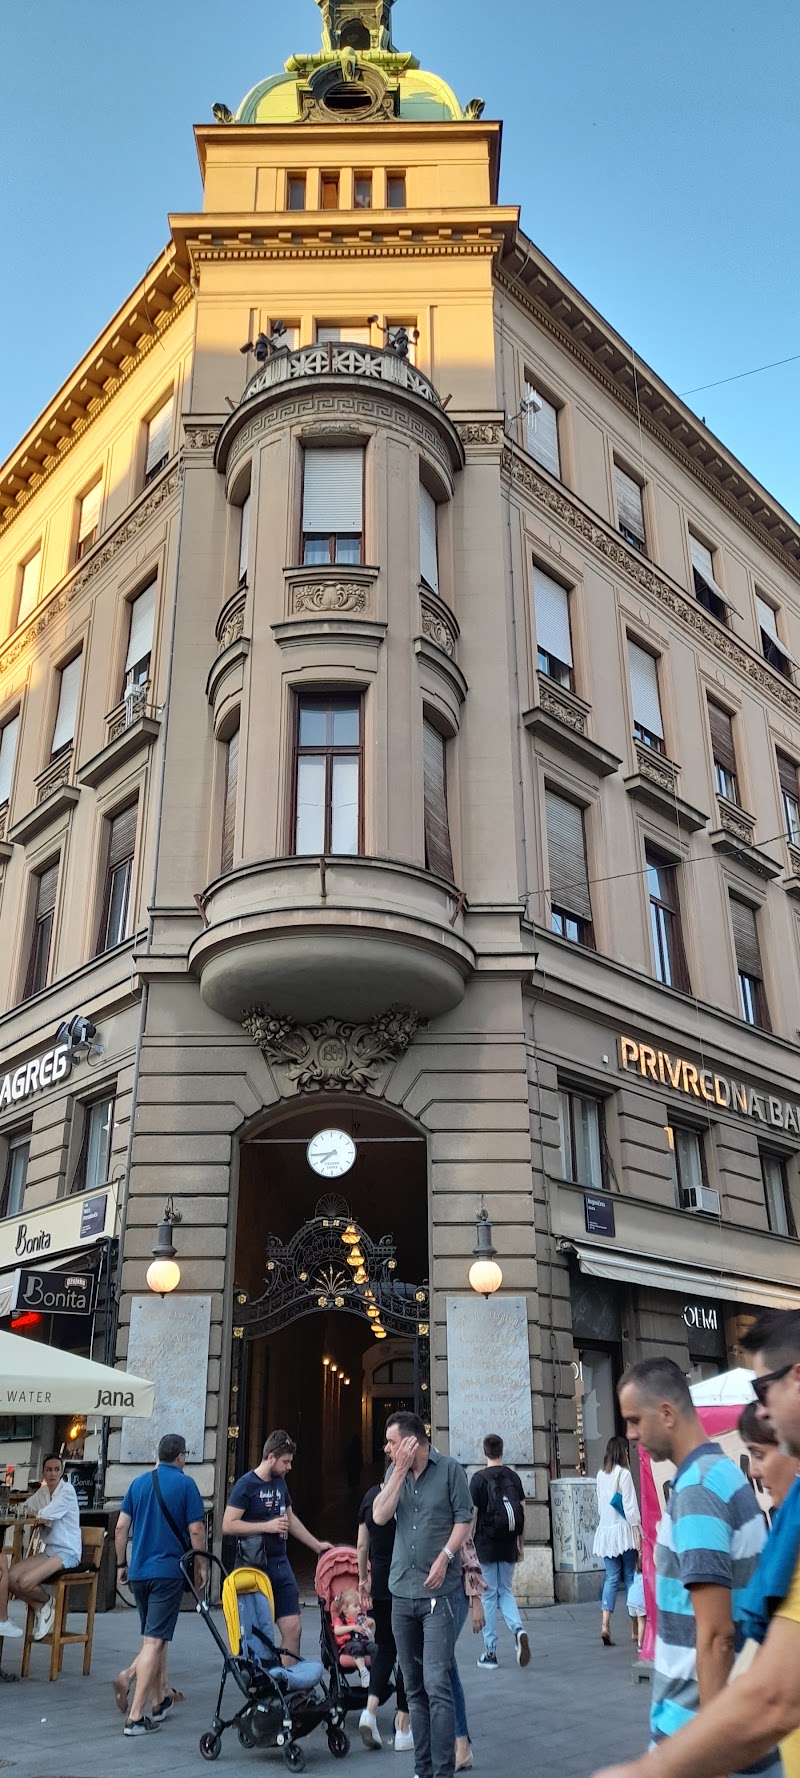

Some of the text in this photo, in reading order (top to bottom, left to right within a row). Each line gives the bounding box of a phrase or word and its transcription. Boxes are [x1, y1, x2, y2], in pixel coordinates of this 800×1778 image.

[619, 1035, 800, 1134] PRIVREDNA BA
[15, 1224, 51, 1256] Bonita
[22, 1275, 87, 1308] Bonita
[7, 1390, 52, 1403] WATER
[94, 1389, 135, 1408] Jana
